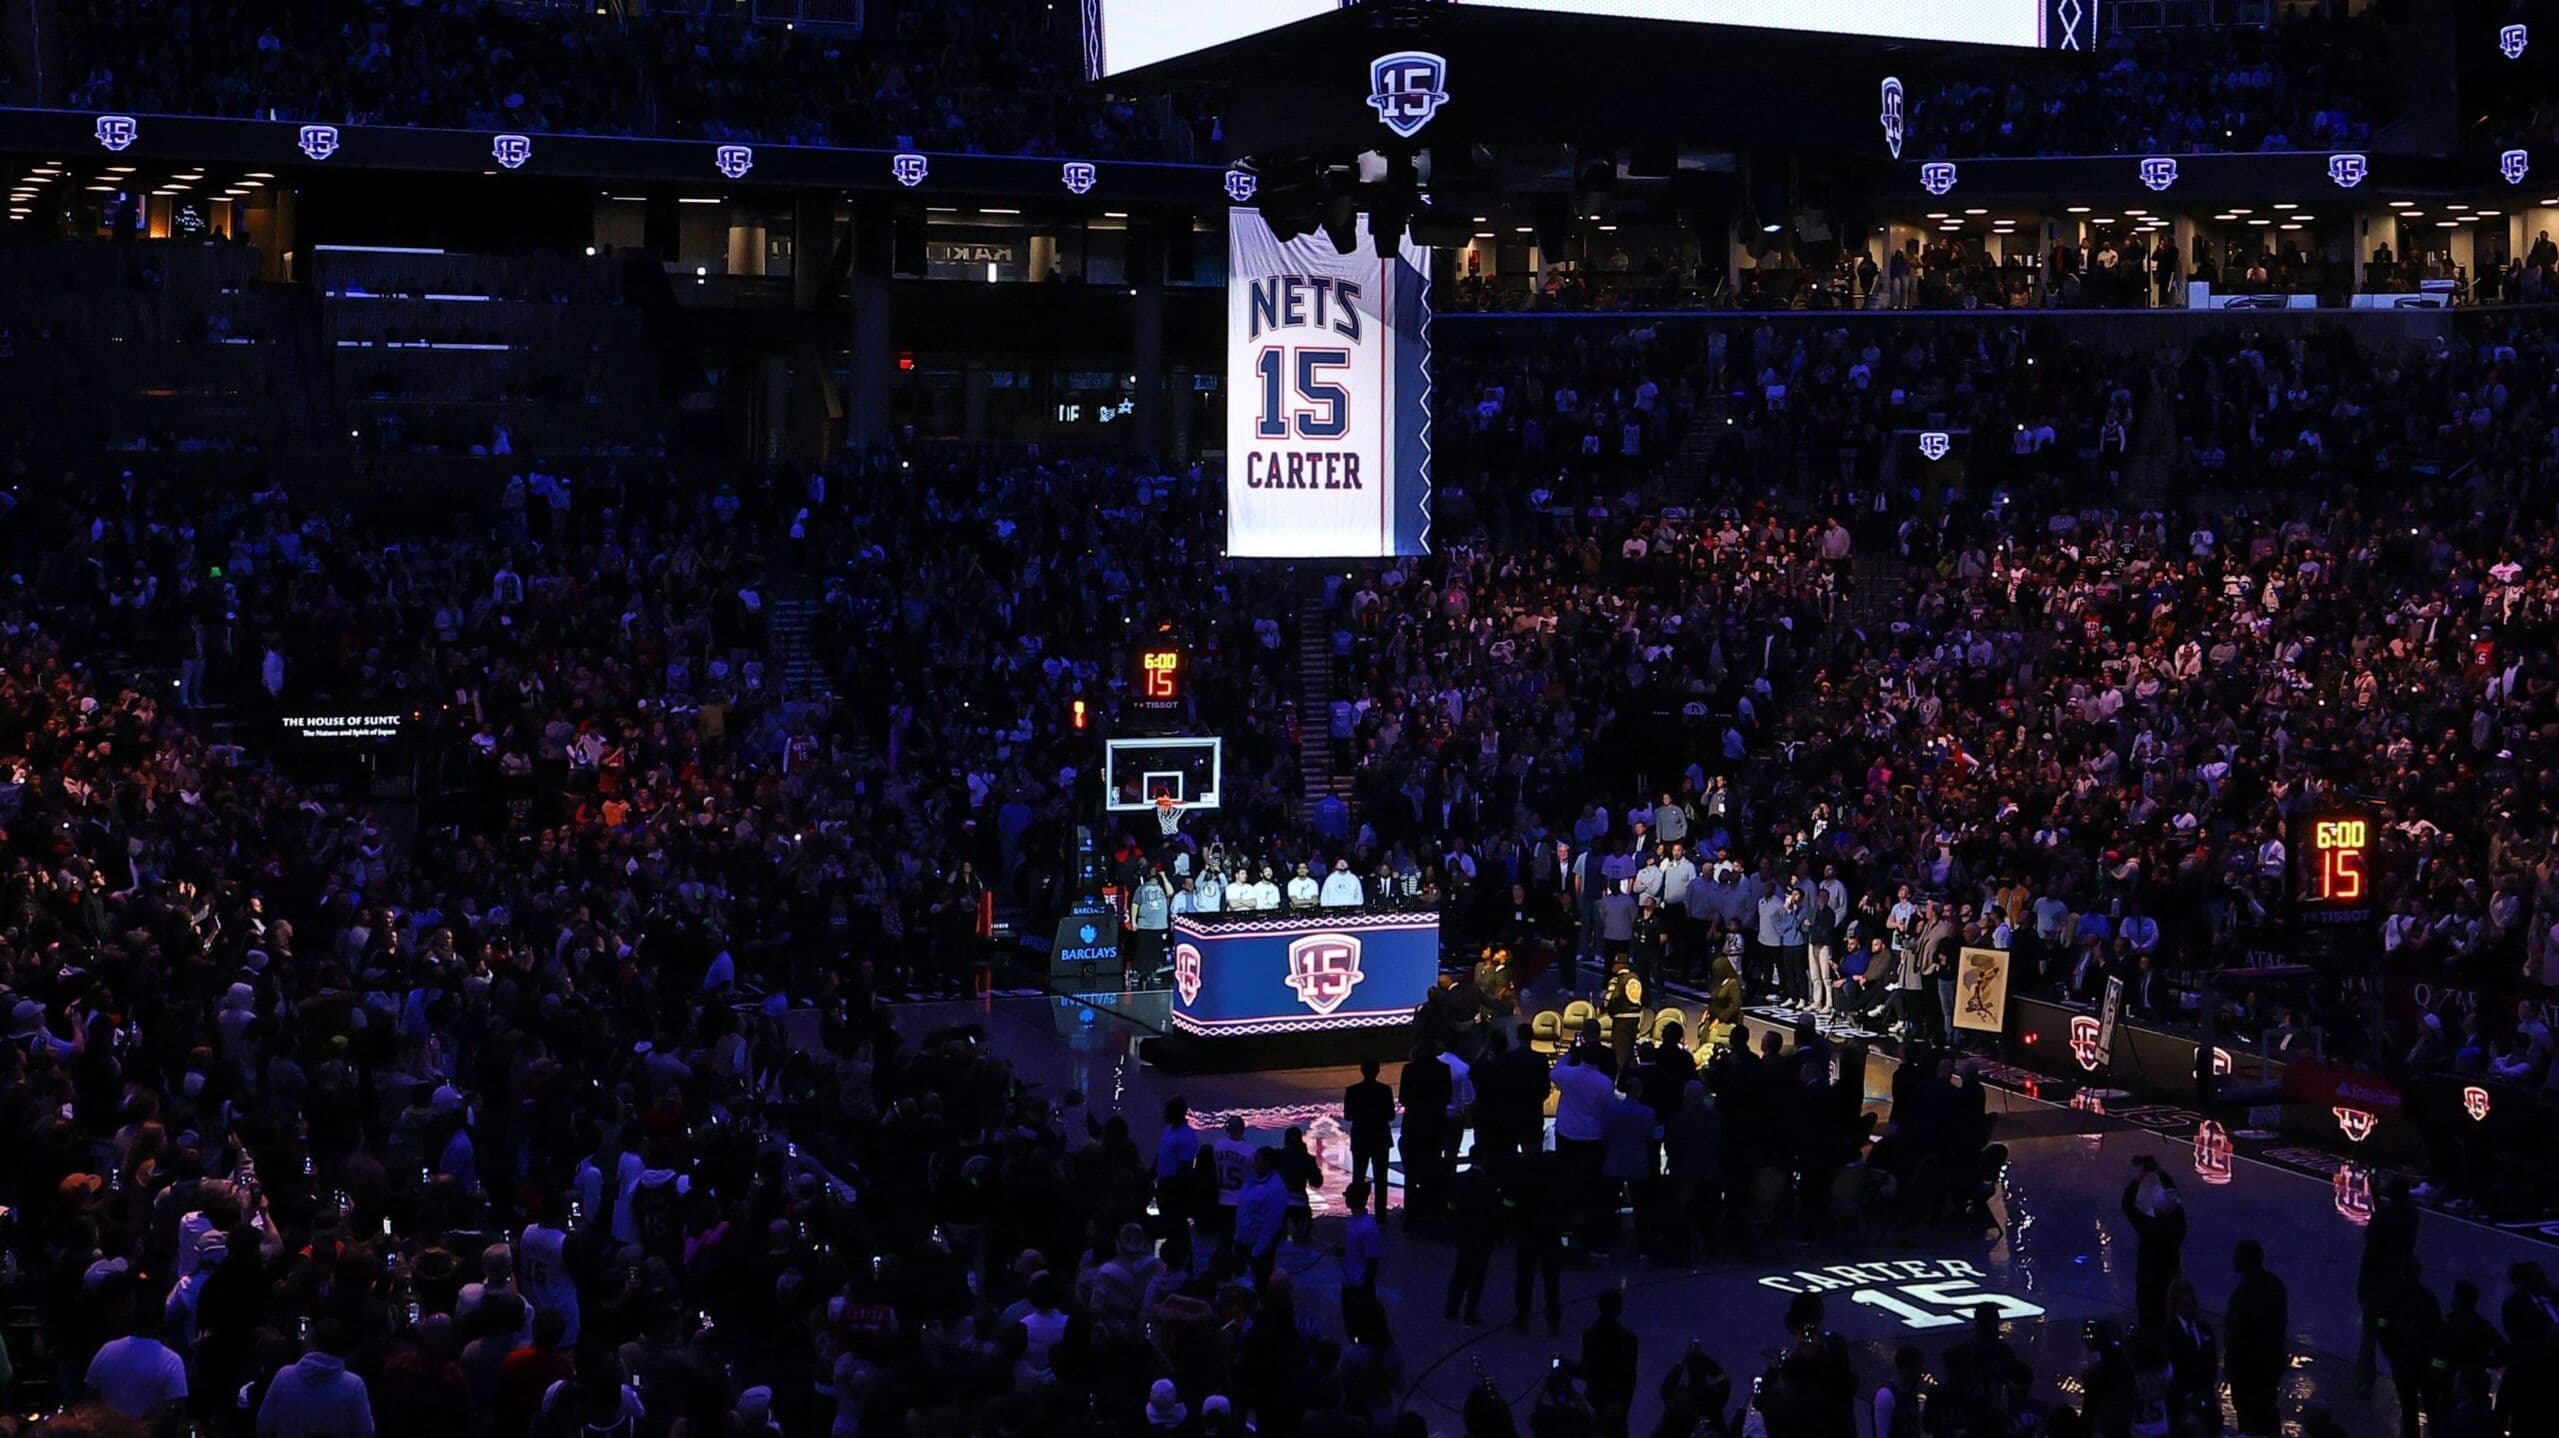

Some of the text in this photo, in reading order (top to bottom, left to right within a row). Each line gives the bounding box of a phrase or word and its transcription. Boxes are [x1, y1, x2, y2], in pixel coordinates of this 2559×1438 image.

[2505, 31, 2521, 51] 15
[1382, 68, 1431, 117] 15
[104, 121, 129, 143] 15
[307, 131, 331, 152] 15
[500, 141, 523, 162] 15
[723, 151, 746, 170] 15
[900, 160, 921, 180] 15
[2147, 163, 2171, 183] 15
[2337, 159, 2360, 180] 15
[2506, 156, 2523, 177] 15
[1070, 169, 1090, 187] 15
[1231, 175, 1251, 195] 15
[1929, 169, 1950, 188] 15
[1249, 275, 1361, 345] NETS
[1256, 346, 1350, 440] 15
[1926, 437, 1944, 455] 15
[1247, 451, 1362, 489] CARTER
[1144, 653, 1177, 669] 6:00
[1148, 669, 1174, 696] 15
[282, 717, 304, 727] THE
[307, 716, 345, 726] HOUSE
[347, 716, 362, 726] OF
[2316, 820, 2366, 849] 6:00
[2323, 850, 2360, 899] 15
[1061, 947, 1117, 961] BARCLAYS
[1180, 954, 1196, 995] 15
[1302, 948, 1348, 996] 15
[1758, 1259, 1987, 1294] CARTER
[1851, 1279, 2046, 1329] 15
